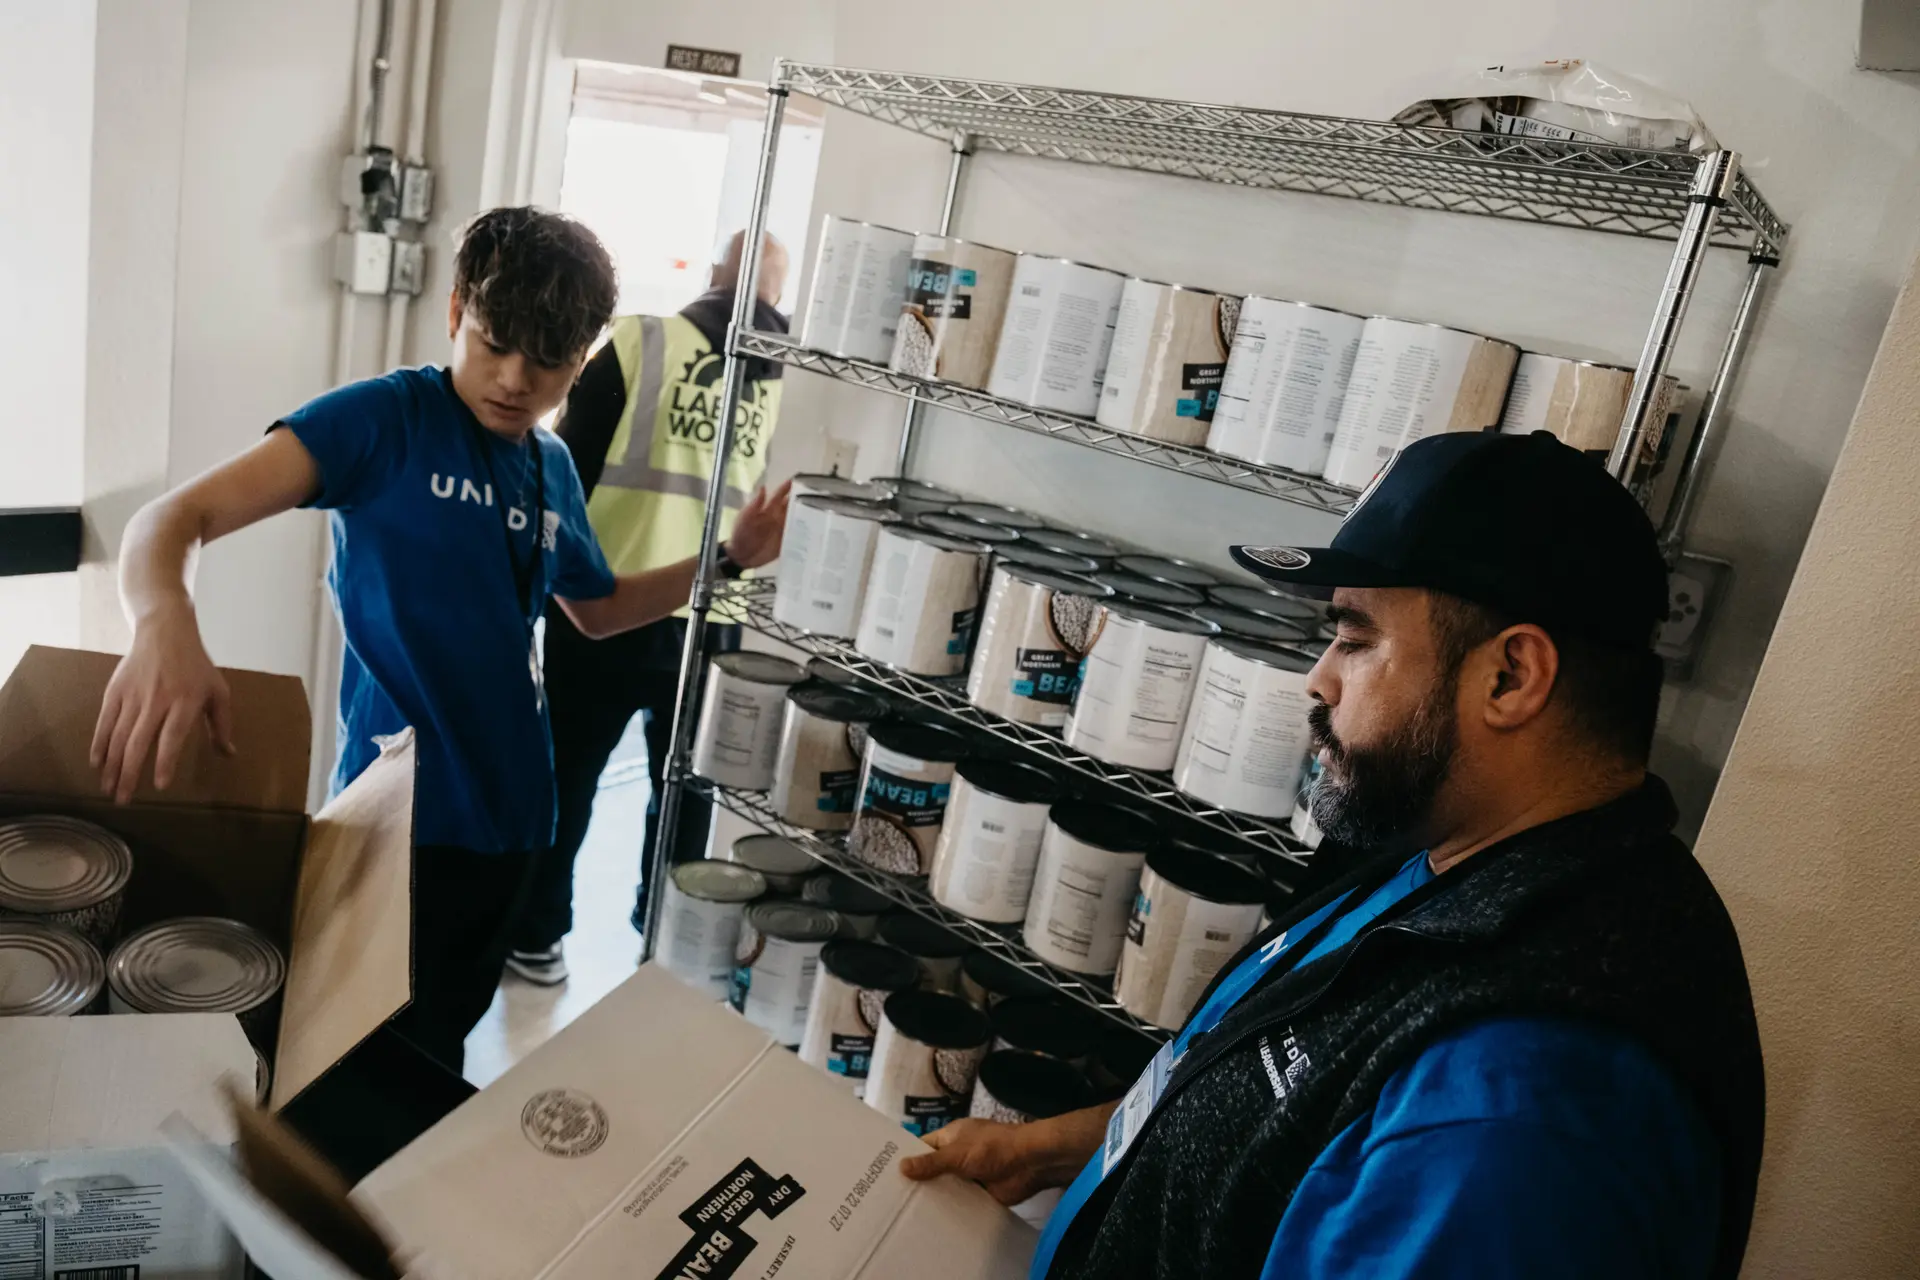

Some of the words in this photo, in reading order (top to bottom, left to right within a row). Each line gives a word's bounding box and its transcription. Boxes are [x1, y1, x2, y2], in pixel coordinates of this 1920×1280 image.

[671, 48, 700, 69] REST
[702, 52, 736, 74] ROOM
[669, 412, 757, 457] WOKS
[430, 472, 528, 531] UNID
[1022, 660, 1062, 669] NORTHERN
[1030, 653, 1055, 661] GREAT
[1260, 1045, 1286, 1099] LEADERSHIP
[696, 1169, 755, 1223] NORTHERN
[720, 1190, 755, 1223] GREAT
[768, 1184, 792, 1207] DRY
[766, 1235, 796, 1279] DESERET
